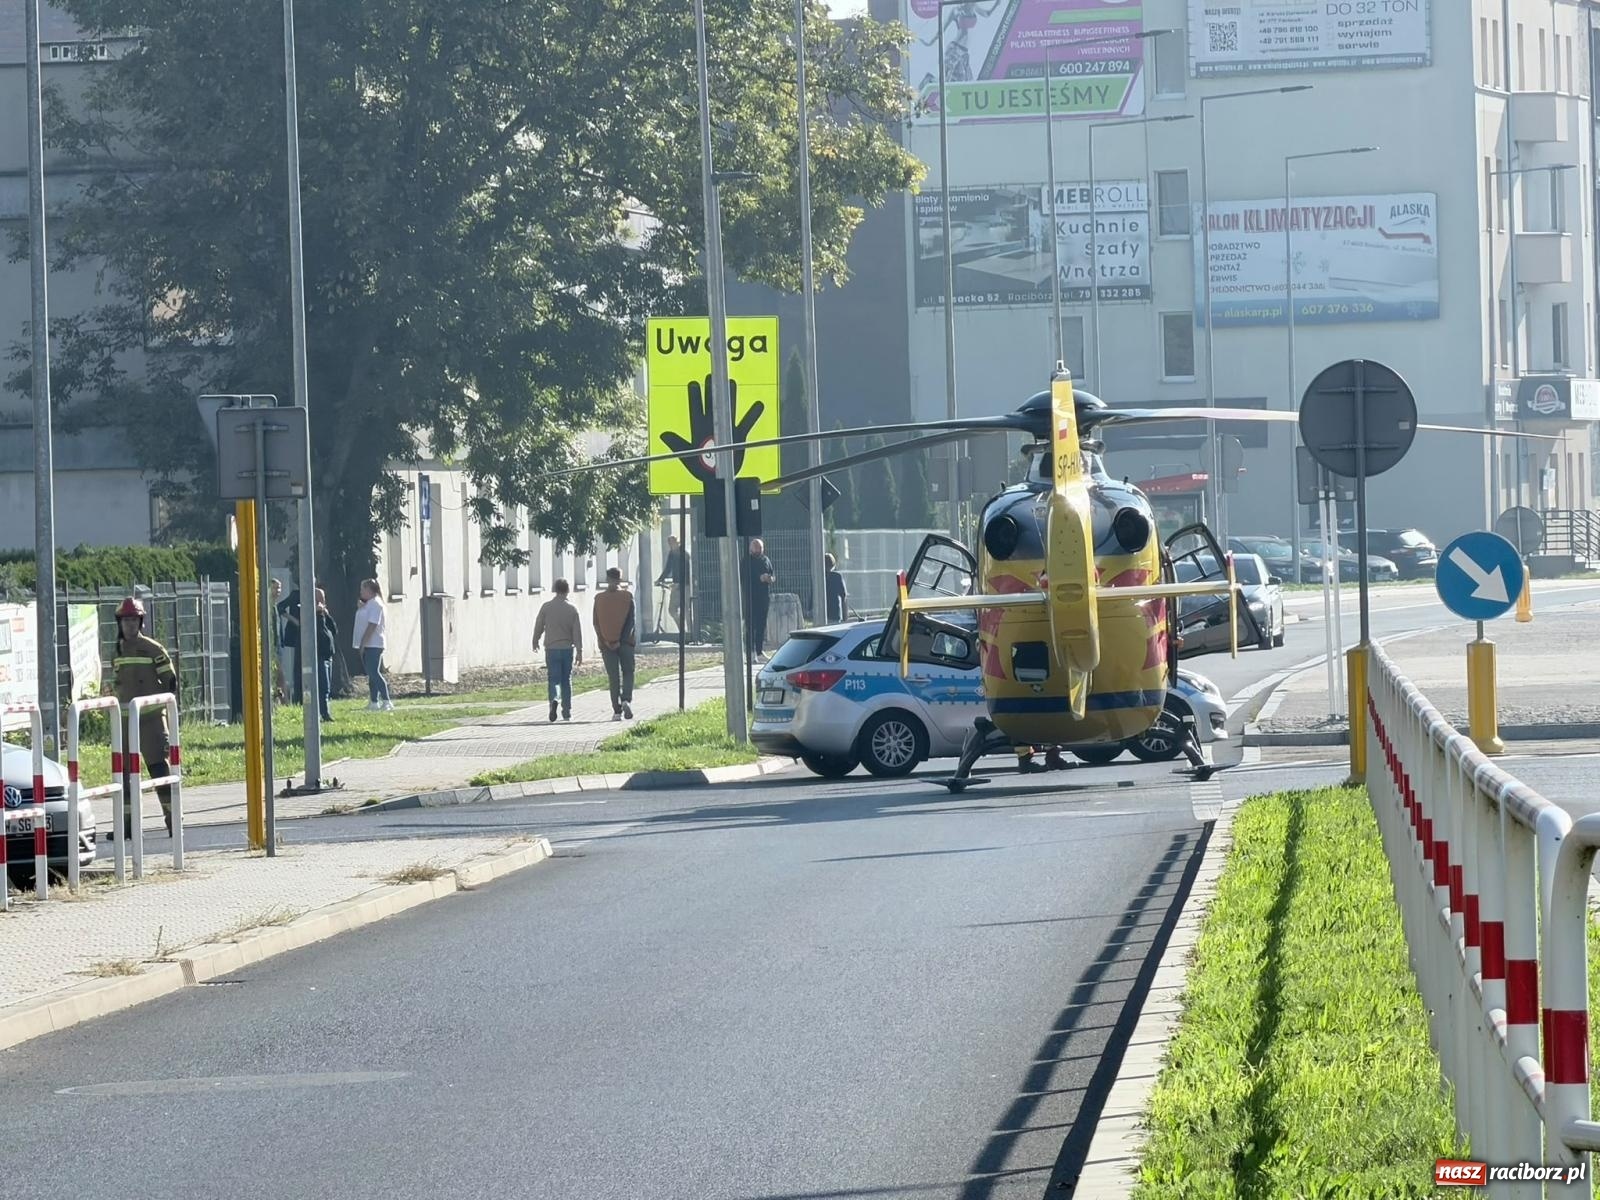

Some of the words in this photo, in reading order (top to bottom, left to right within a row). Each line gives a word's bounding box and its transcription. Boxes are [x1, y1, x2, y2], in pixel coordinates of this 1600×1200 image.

[1326, 3, 1352, 16] DO
[1356, 1, 1376, 14] 32
[1381, 0, 1418, 13] TON
[1337, 29, 1392, 40] wynajem
[1337, 41, 1379, 50] serwis
[1059, 63, 1083, 74] 600
[1085, 62, 1105, 73] 247
[1107, 61, 1130, 72] 894
[962, 91, 989, 110] TU
[998, 82, 1110, 109] JESTEŚMY
[915, 195, 939, 205] Blaty
[1390, 203, 1431, 219] ALASKA
[1244, 205, 1376, 233] KLIMATYZACJI
[1056, 218, 1139, 235] Kuchnie
[1209, 242, 1261, 251] ORADZTWO
[1210, 253, 1248, 261] PRZEDAŻ
[1210, 274, 1238, 282] ERWIS
[938, 294, 984, 303] Bsacka
[1302, 304, 1323, 316] 607
[1327, 304, 1348, 315] 376
[1352, 303, 1375, 314] 336
[845, 679, 866, 690] P113
[18, 817, 31, 832] SG
